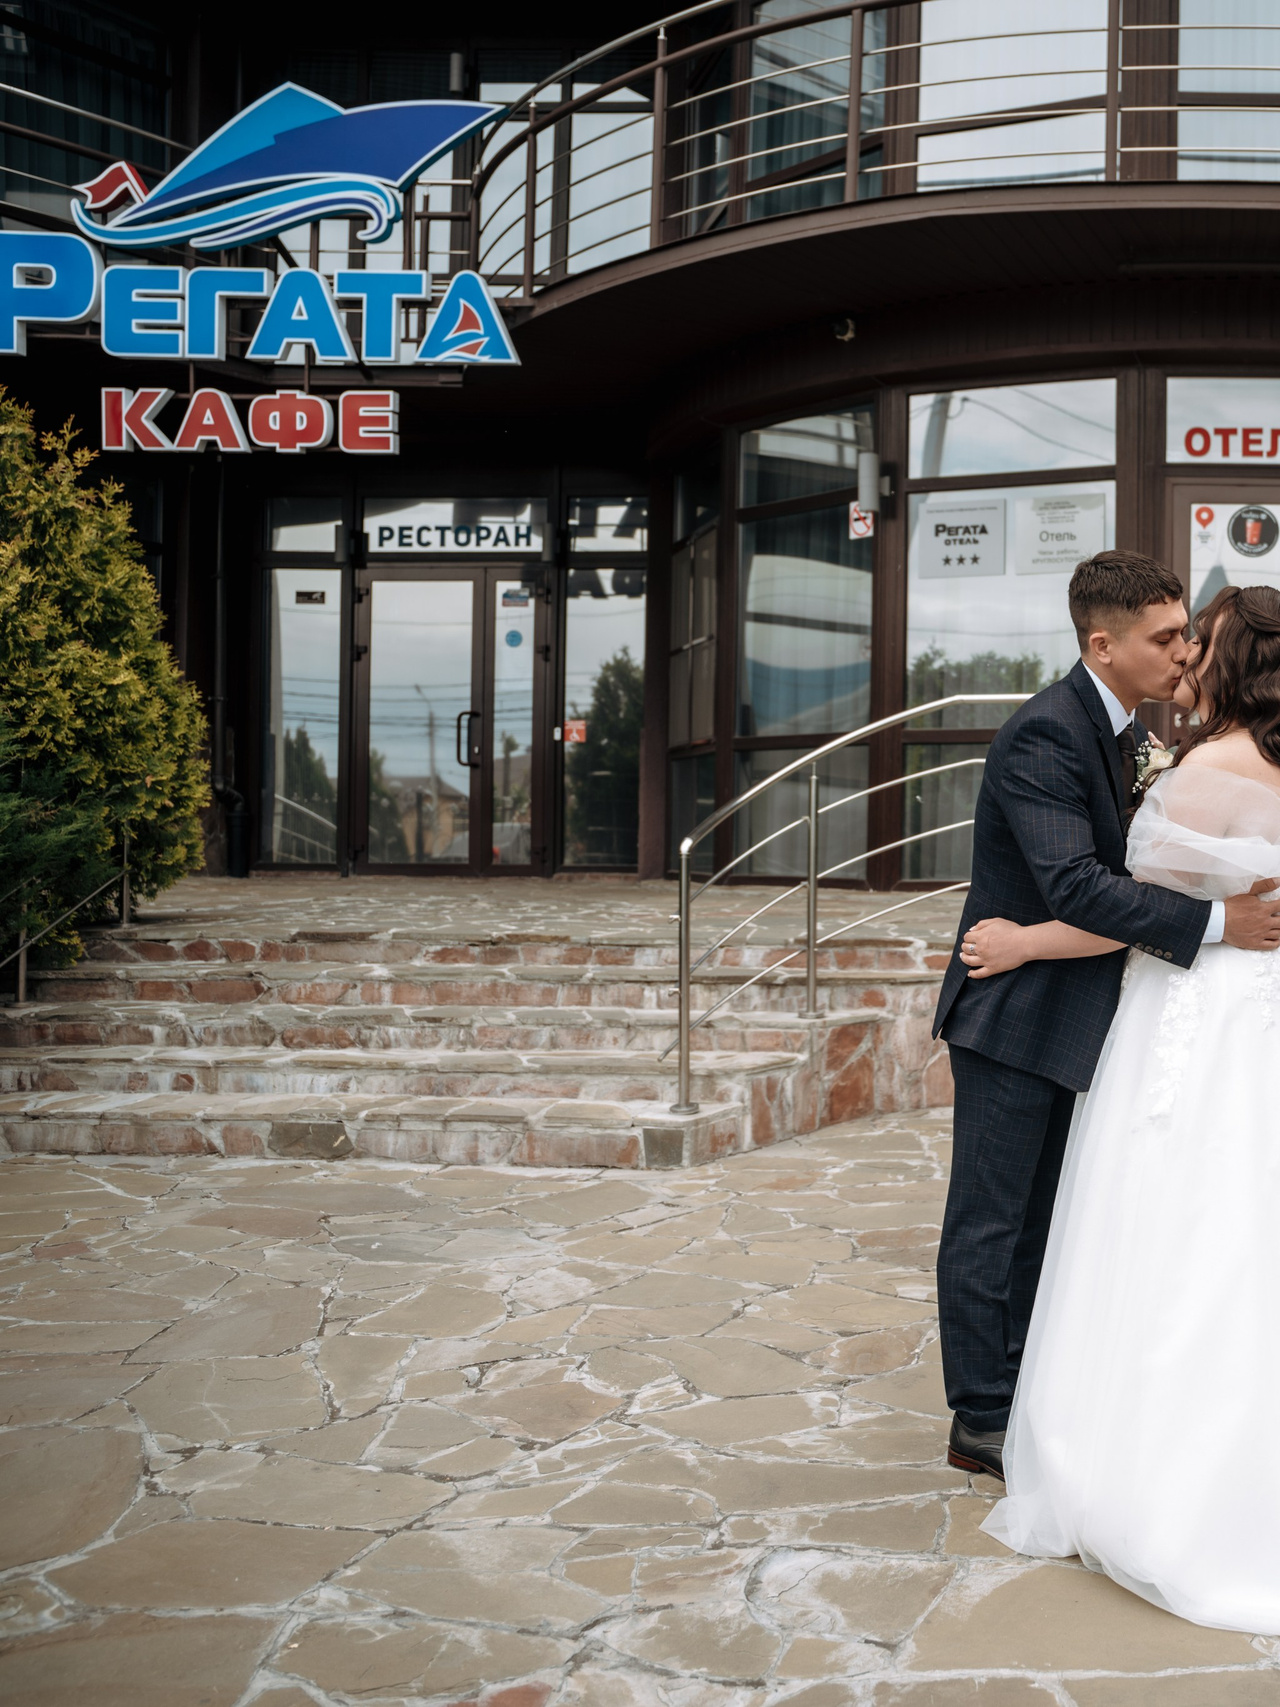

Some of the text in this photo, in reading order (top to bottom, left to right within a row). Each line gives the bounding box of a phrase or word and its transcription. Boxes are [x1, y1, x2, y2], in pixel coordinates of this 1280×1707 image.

[0, 230, 520, 366] РЕГАТА
[101, 387, 400, 454] КАФЕ
[377, 525, 532, 547] РЕСТОРАН
[934, 523, 989, 537] РЕГАТА
[1039, 530, 1077, 542] Отель
[944, 537, 980, 546] ОТЕЛЬ
